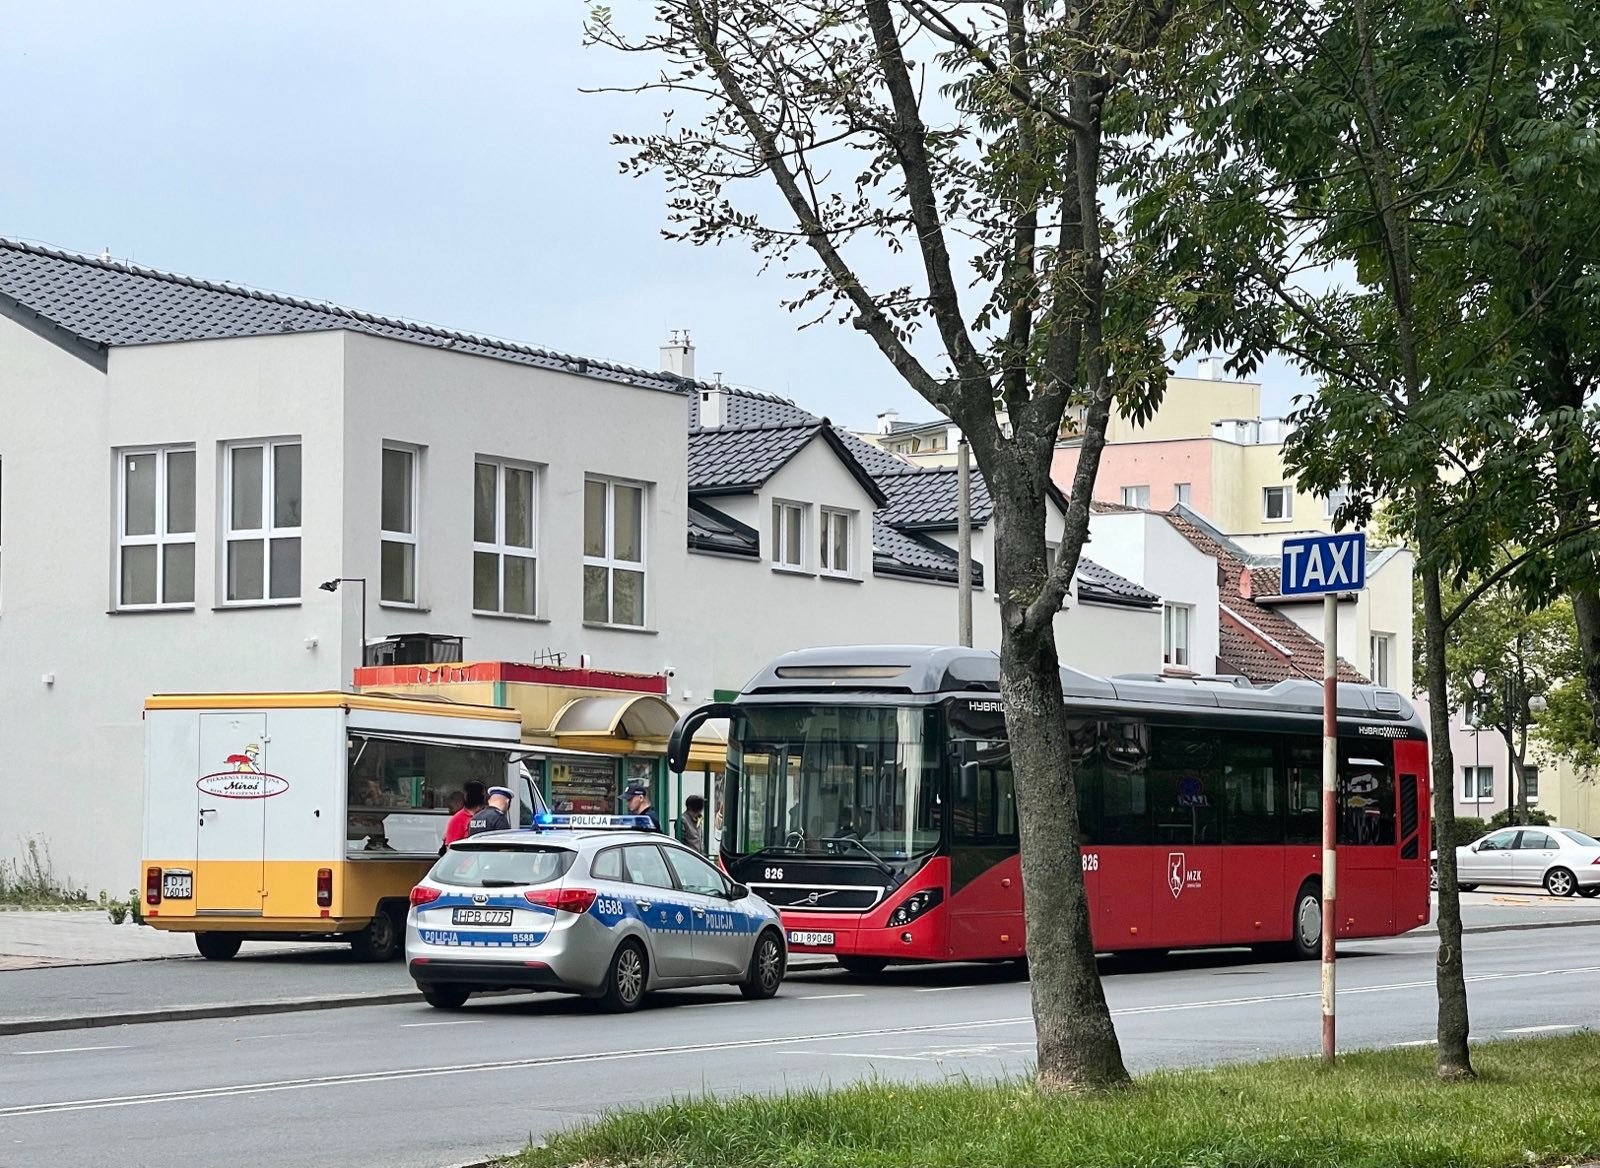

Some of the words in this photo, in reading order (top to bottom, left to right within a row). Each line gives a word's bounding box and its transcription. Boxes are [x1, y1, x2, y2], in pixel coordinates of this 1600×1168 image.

[1284, 540, 1360, 588] TAXI
[1358, 725, 1384, 736] HYBRID
[224, 781, 259, 790] Miroś
[571, 816, 608, 825] POLICJA
[1082, 854, 1099, 871] 826
[764, 868, 783, 880] 826
[1186, 870, 1202, 881] MZK
[171, 876, 184, 887] DJ
[165, 888, 190, 898] 76015
[596, 899, 622, 915] B588
[459, 911, 482, 922] HPB
[484, 912, 510, 923] C775
[704, 914, 733, 929] POLICJA
[425, 931, 458, 943] POLICJA
[512, 933, 535, 942] B588
[793, 933, 804, 942] DJ
